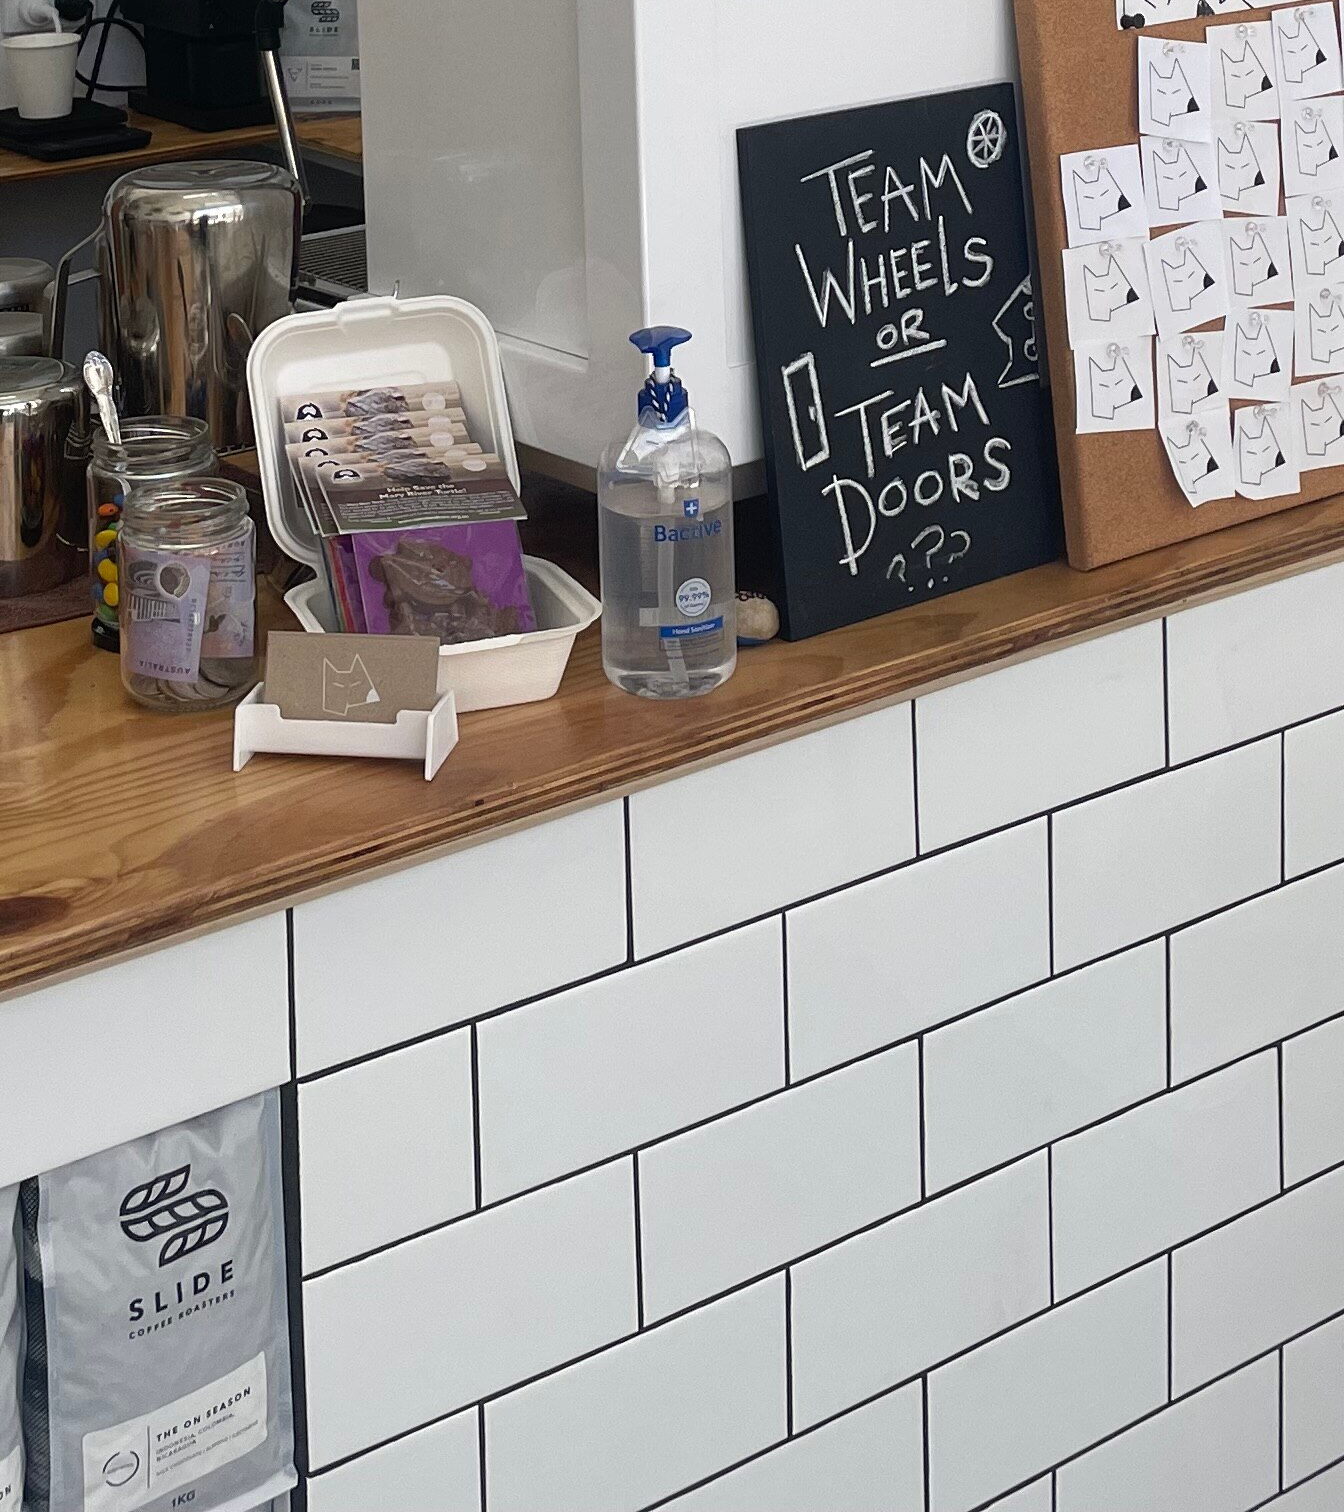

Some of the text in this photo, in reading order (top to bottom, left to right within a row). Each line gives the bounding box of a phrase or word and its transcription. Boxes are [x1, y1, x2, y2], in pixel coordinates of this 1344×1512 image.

[801, 148, 974, 238] TEAM
[795, 215, 994, 328] WHEELS
[876, 307, 931, 352] OR
[834, 372, 991, 479] TEAM
[654, 519, 722, 543] Bactive
[821, 436, 1012, 576] DOORS
[678, 591, 710, 603] 99.99%
[672, 626, 690, 635] Hand
[128, 1259, 236, 1323] SLIDE
[128, 1289, 237, 1340] COFFEE ROASTERS
[156, 1386, 252, 1442] THE ON SEASON
[171, 1489, 197, 1508] 1KG
